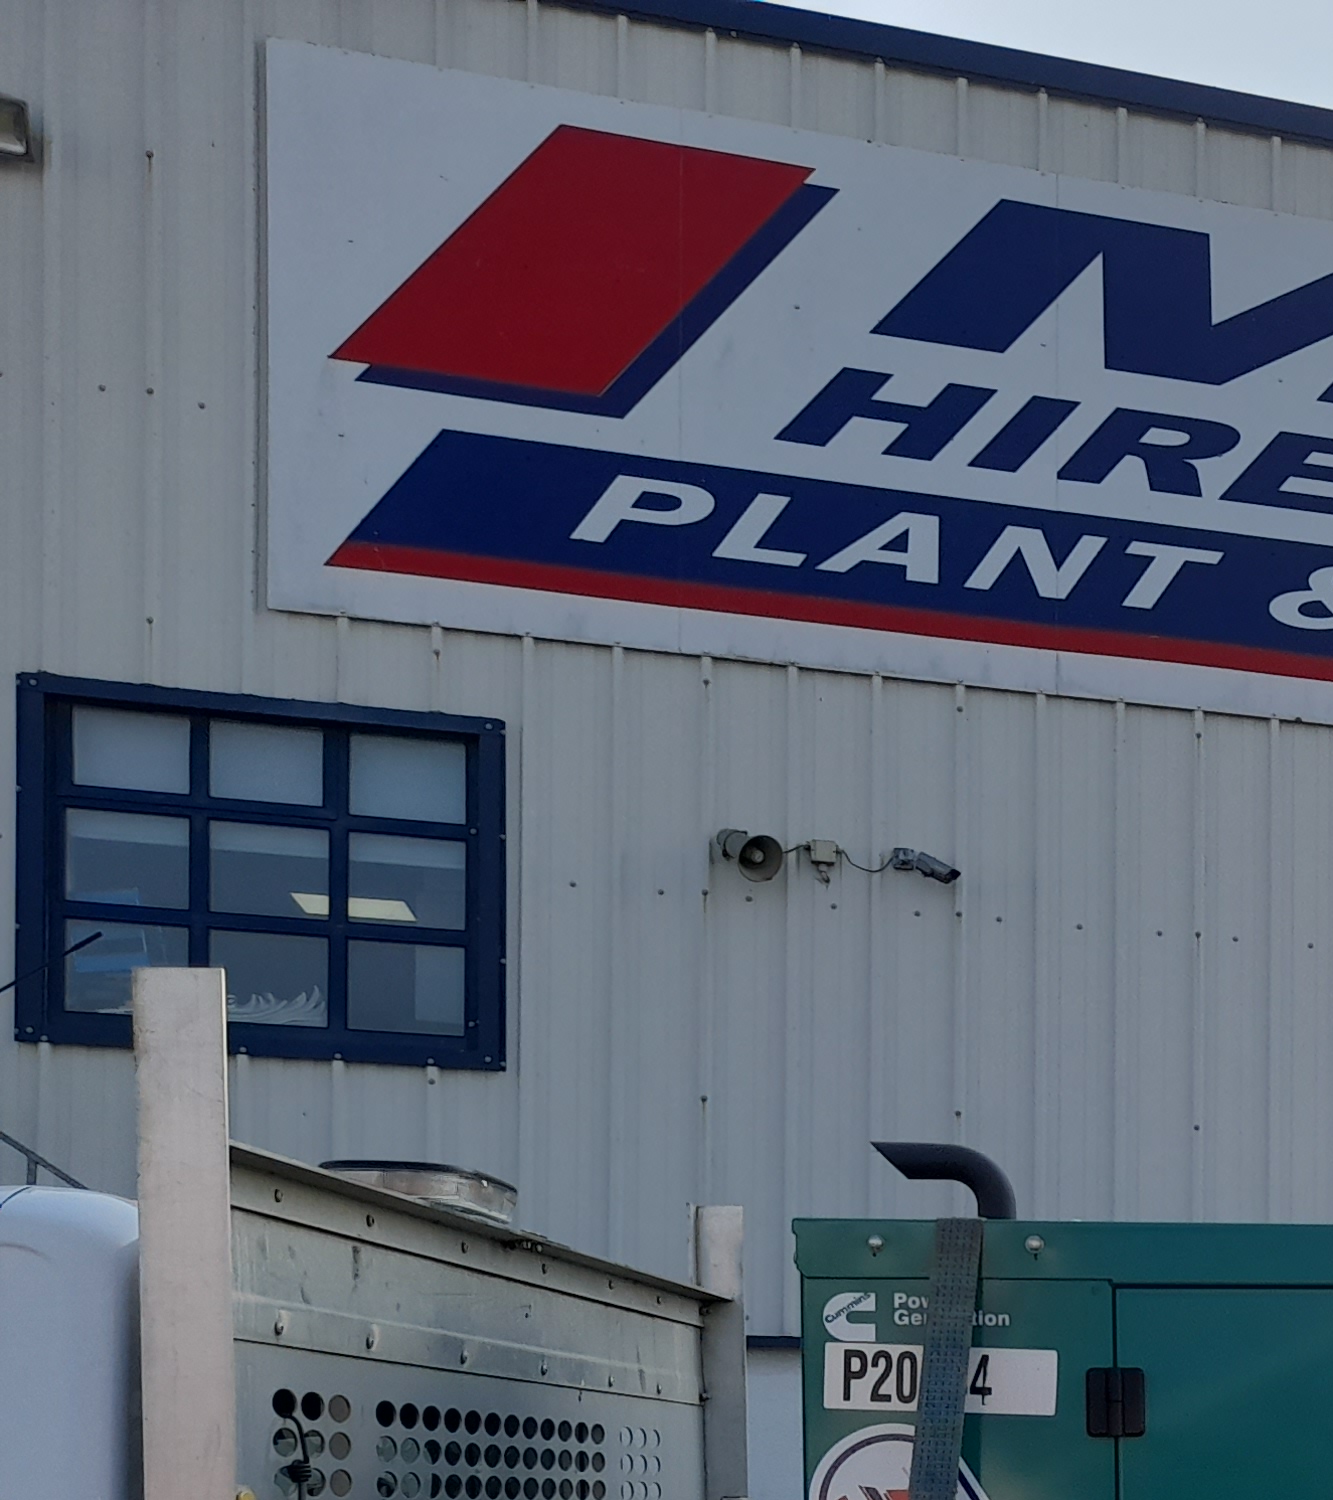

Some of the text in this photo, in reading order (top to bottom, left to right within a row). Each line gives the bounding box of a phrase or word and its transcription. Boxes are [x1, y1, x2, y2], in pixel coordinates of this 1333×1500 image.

[569, 473, 1222, 610] PLANT
[824, 1292, 872, 1324] Cummins
[843, 1349, 992, 1405] P204
